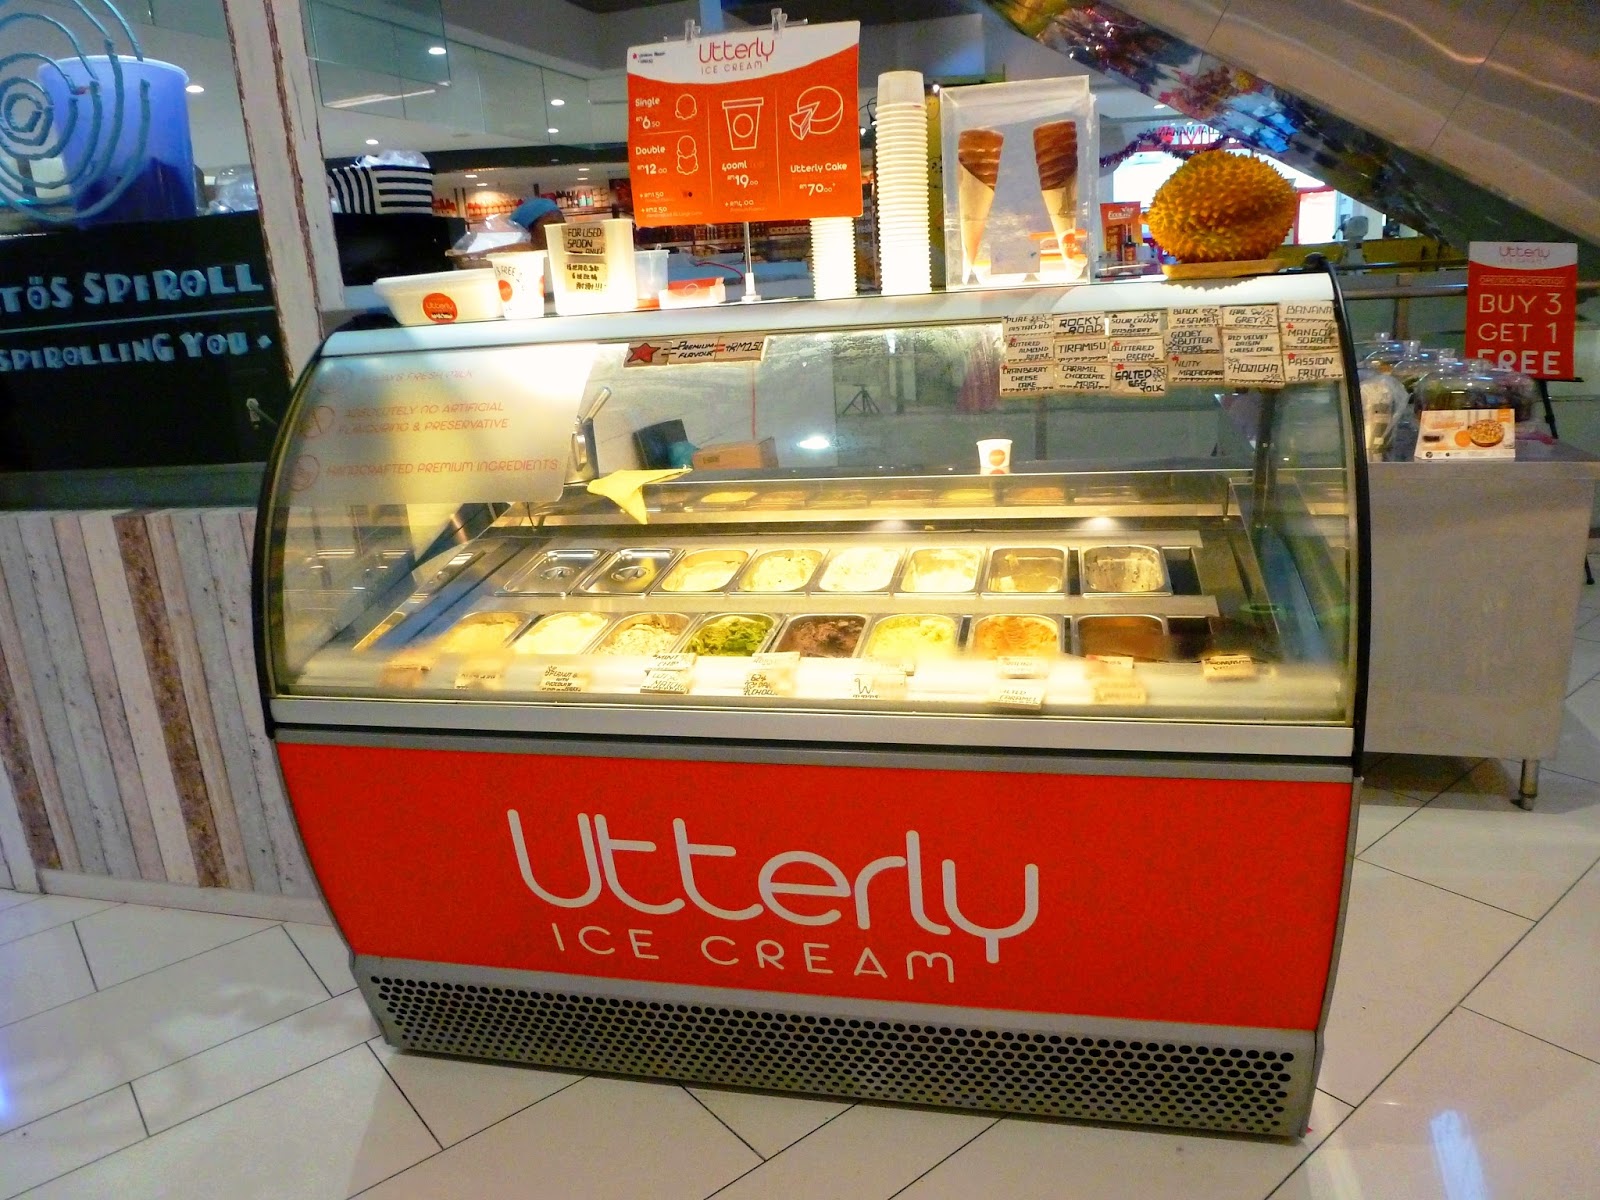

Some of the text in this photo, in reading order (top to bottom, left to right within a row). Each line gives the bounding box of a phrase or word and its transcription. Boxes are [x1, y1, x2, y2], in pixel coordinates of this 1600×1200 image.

[698, 37, 775, 62] Utterly
[701, 61, 763, 75] ICE CREAM
[635, 97, 660, 108] Single
[635, 145, 665, 155] Double
[721, 160, 747, 172] 400ml
[790, 162, 847, 173] Utterly Cake
[567, 227, 602, 238] FOR USED
[567, 239, 592, 249] SPOON
[1499, 245, 1550, 258] Utterly
[83, 263, 264, 304] SPIROLL
[1479, 292, 1562, 315] BUY 3
[1286, 305, 1332, 314] BANANA
[1059, 316, 1100, 328] ROCKY
[1235, 316, 1258, 324] GREY
[1068, 324, 1103, 334] ROAD
[1288, 328, 1327, 336] MANGO
[1478, 321, 1557, 344] GET 1
[1059, 341, 1107, 354] TIRAMISU
[1288, 356, 1334, 366] PASSION
[1003, 366, 1048, 374] CRANBERRY
[1062, 365, 1098, 373] CARAMEL
[1115, 369, 1152, 380] SALTED
[1140, 384, 1165, 393] YOLK
[441, 402, 503, 414] ARTIFICIAL
[413, 422, 421, 432] &
[425, 418, 509, 431] PRESERVATIVE
[417, 460, 473, 473] PREMIUM
[477, 458, 558, 471] INGREDIENTS
[507, 808, 1039, 963] Utterly
[551, 922, 955, 983] ICE CREAM
